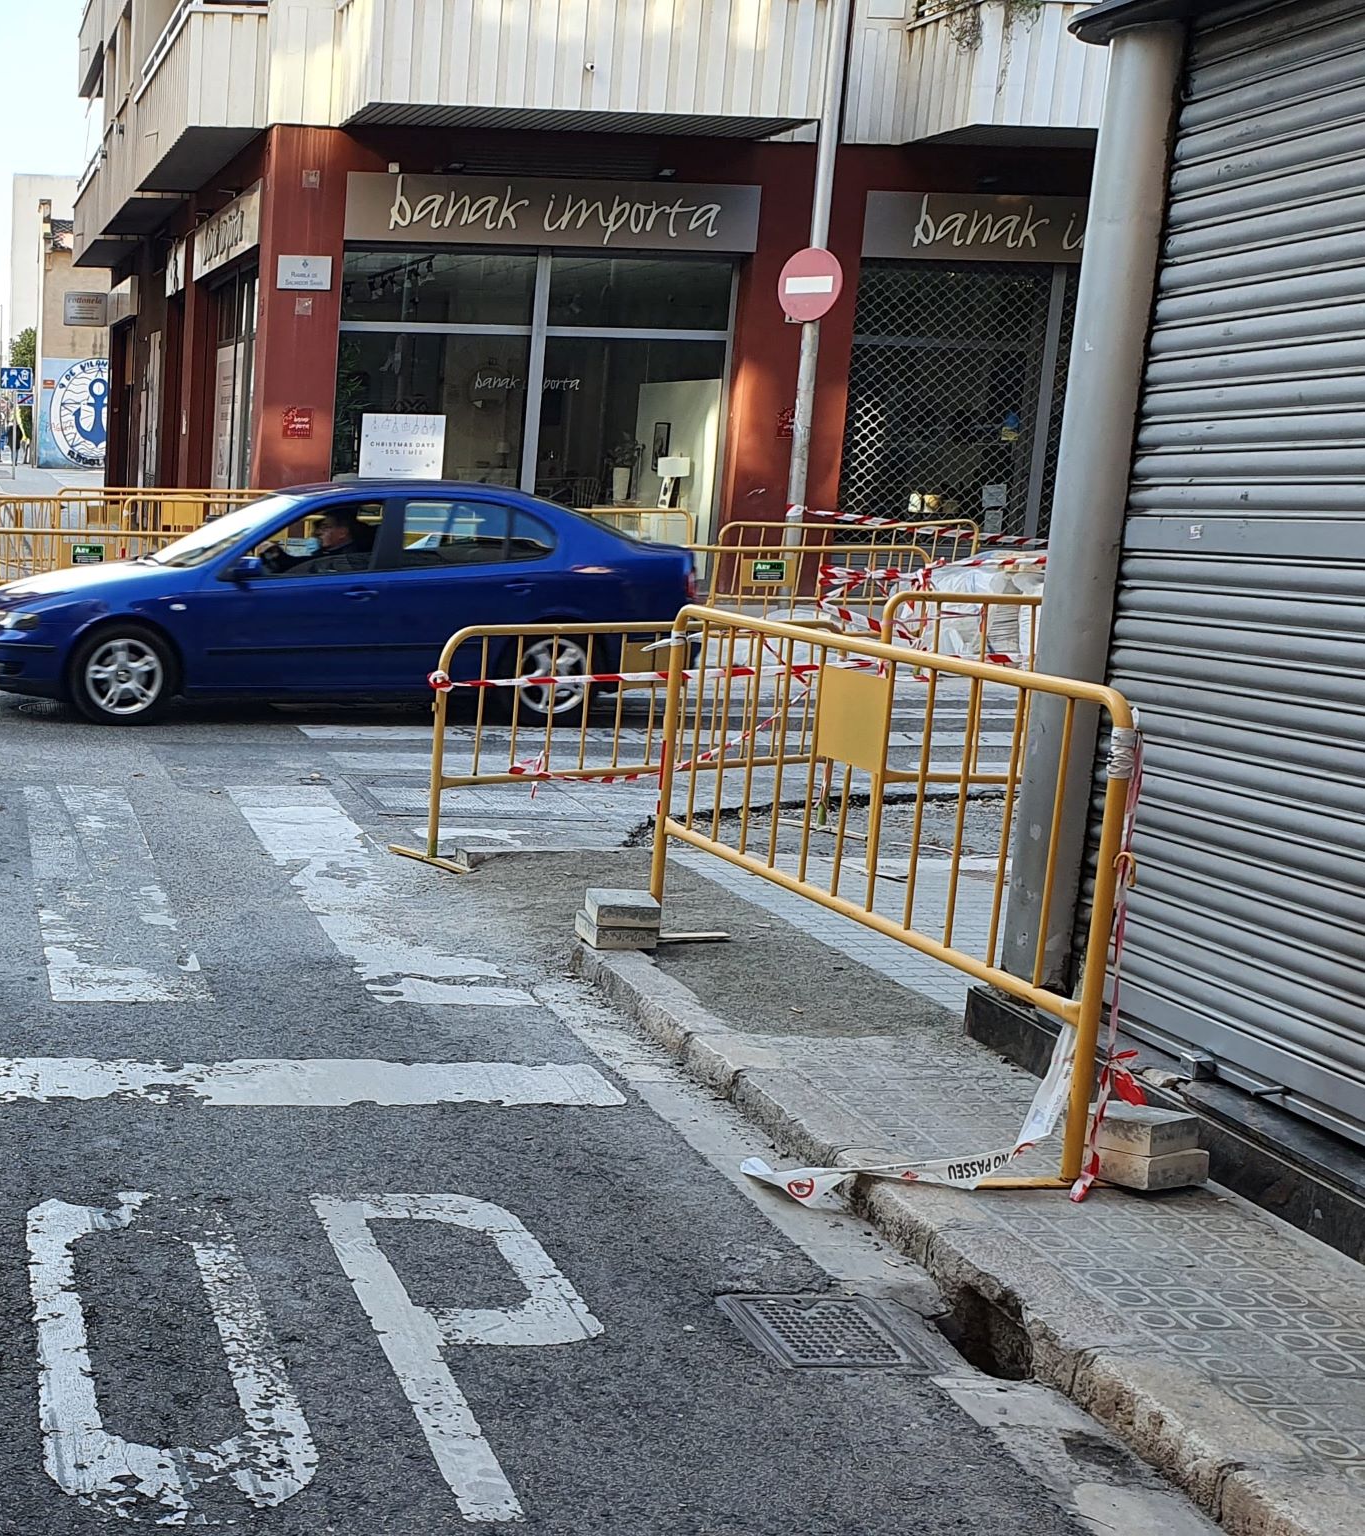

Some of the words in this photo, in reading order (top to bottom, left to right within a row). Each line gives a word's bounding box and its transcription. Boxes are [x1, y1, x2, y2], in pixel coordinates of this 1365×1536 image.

[389, 174, 530, 230] banak
[542, 193, 722, 245] importa
[912, 193, 1050, 248] banak
[474, 371, 521, 391] banak
[947, 1157, 992, 1180] PASSEU
[994, 1153, 1010, 1168] NO
